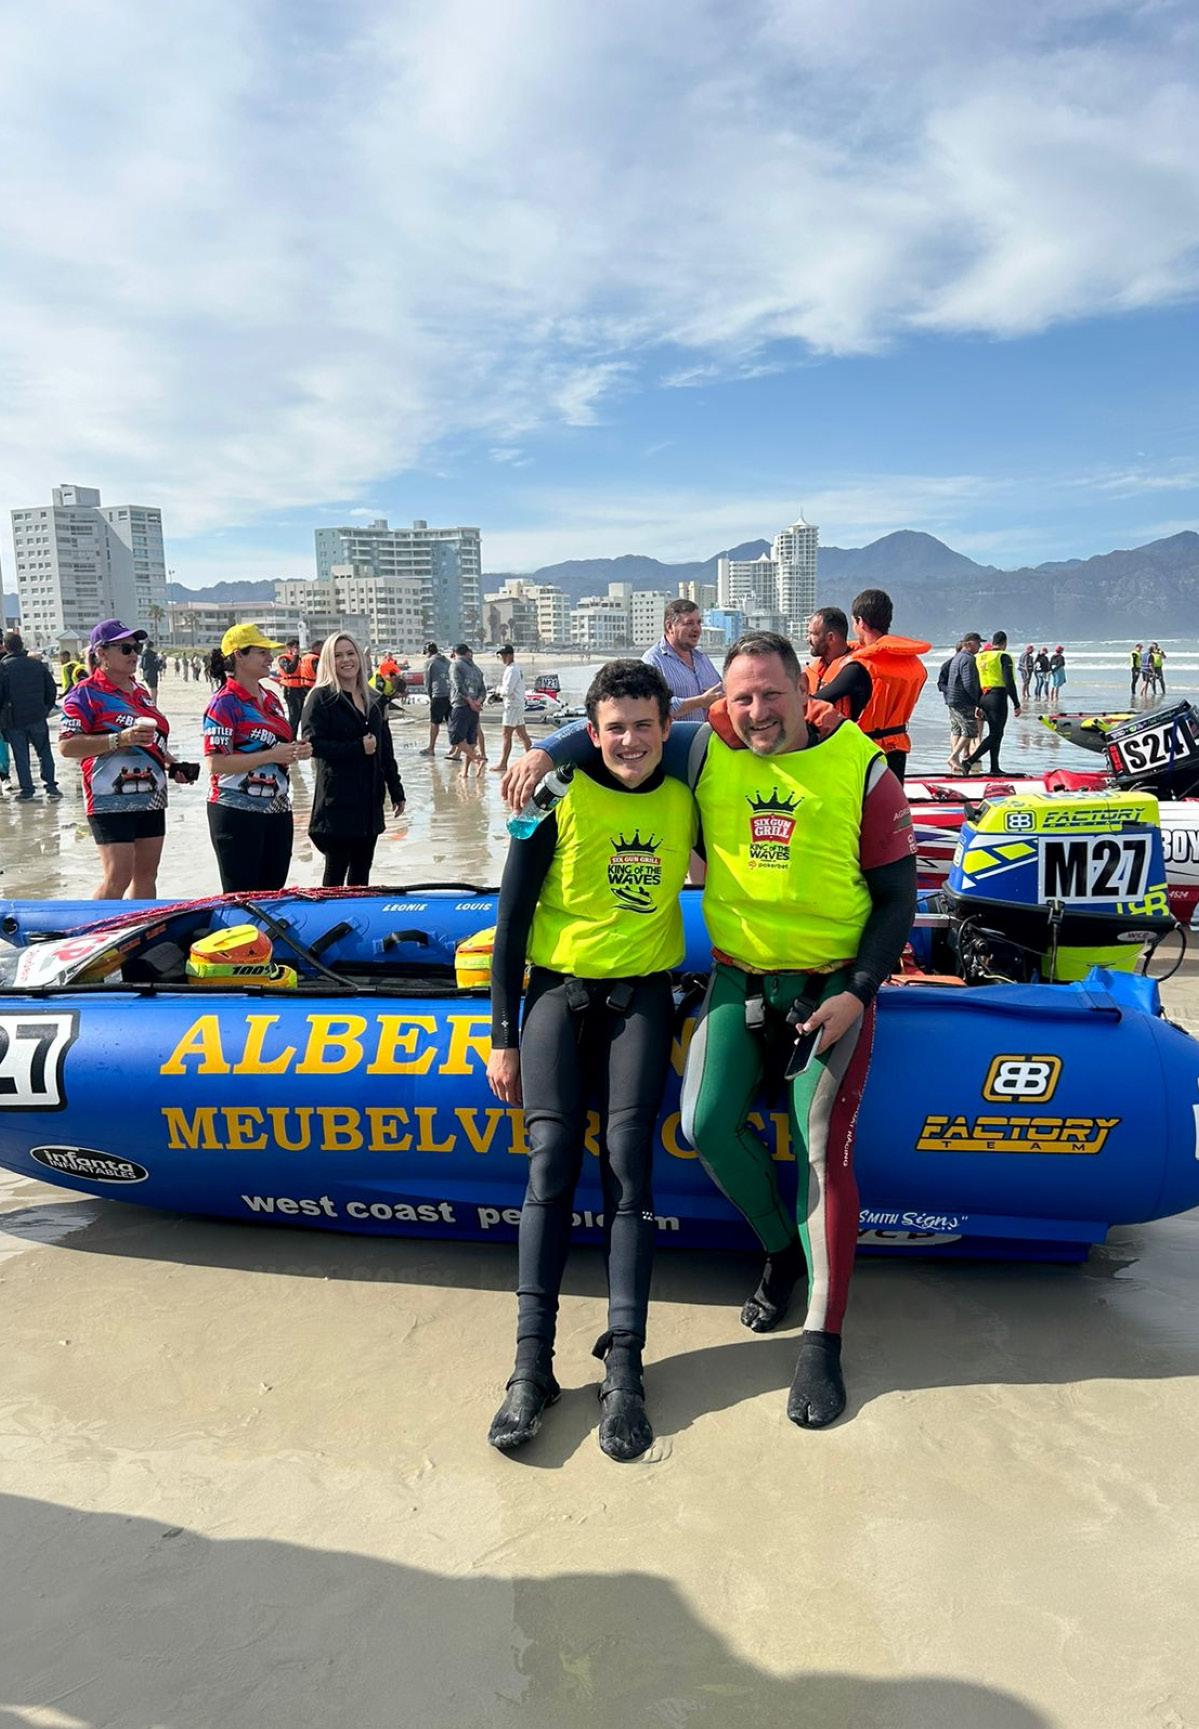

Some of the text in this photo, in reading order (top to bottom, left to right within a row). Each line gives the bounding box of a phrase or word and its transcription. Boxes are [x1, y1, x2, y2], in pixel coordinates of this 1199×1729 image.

[1123, 727, 1184, 769] S24
[1044, 807, 1146, 823] FACTORY
[753, 817, 792, 830] SIX GUN
[754, 825, 790, 839] GRILL
[750, 850, 790, 861] WAVES
[608, 865, 632, 875] KING
[646, 866, 662, 875] THE
[1044, 838, 1147, 898] M27
[608, 874, 661, 885] WAVES
[382, 903, 428, 912] LEONIE
[455, 902, 493, 911] LOUIS
[920, 1115, 1122, 1143] FACTORY
[942, 1140, 1085, 1152] TEAM
[43, 1150, 134, 1173] Infanta
[241, 1194, 338, 1217] west
[346, 1201, 456, 1223] coast
